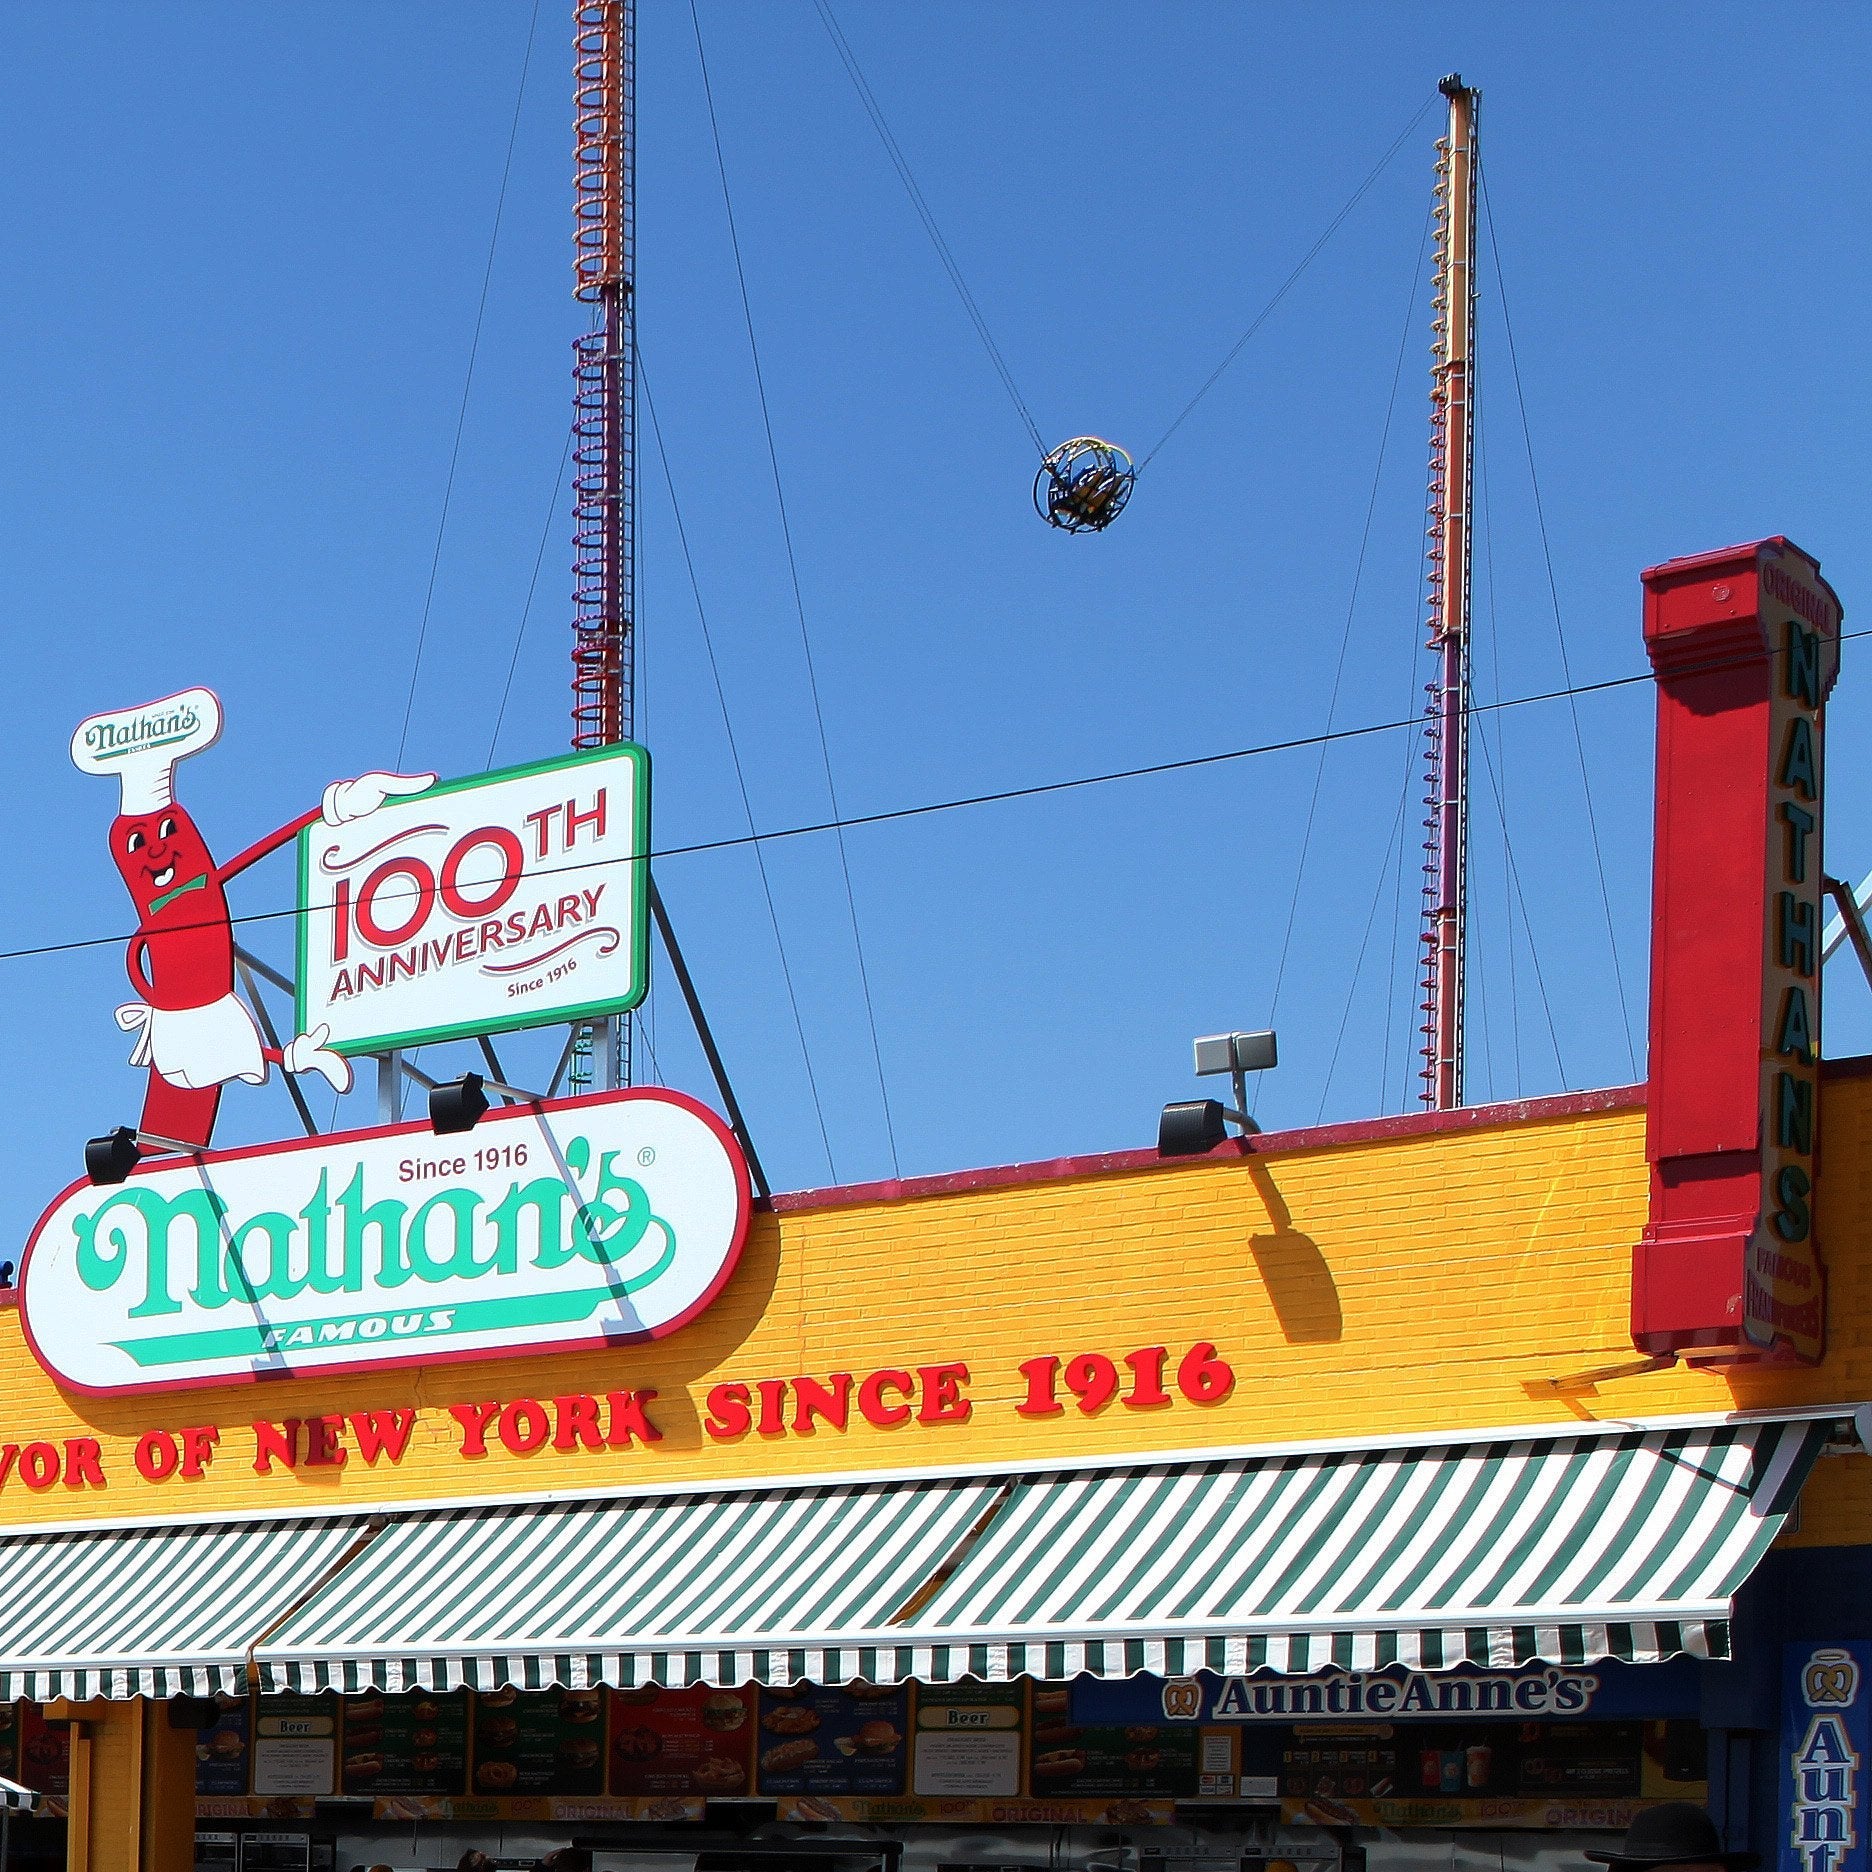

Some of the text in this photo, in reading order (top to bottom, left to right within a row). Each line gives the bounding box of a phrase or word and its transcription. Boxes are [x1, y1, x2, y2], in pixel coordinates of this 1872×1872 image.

[1762, 561, 1834, 638] ORIGINAL
[85, 704, 200, 751] Nathan's
[330, 884, 606, 1001] ANNIVERSARY
[1777, 620, 1820, 1243] NATHANS
[507, 957, 578, 997] Since 1916
[398, 1144, 529, 1182] Since 1916
[73, 1135, 677, 1318] Nathan's
[261, 1309, 456, 1349] FAMOUS
[134, 1425, 219, 1481] OF
[251, 1407, 416, 1474] NEW
[449, 1388, 664, 1457] YORK
[704, 1363, 972, 1439] SINCE
[1016, 1341, 1235, 1418] 1916
[279, 1720, 311, 1733] Beer
[946, 1709, 990, 1726] Beer
[196, 1804, 250, 1816] RIGINAL
[992, 1806, 1088, 1824] ORIGINAL
